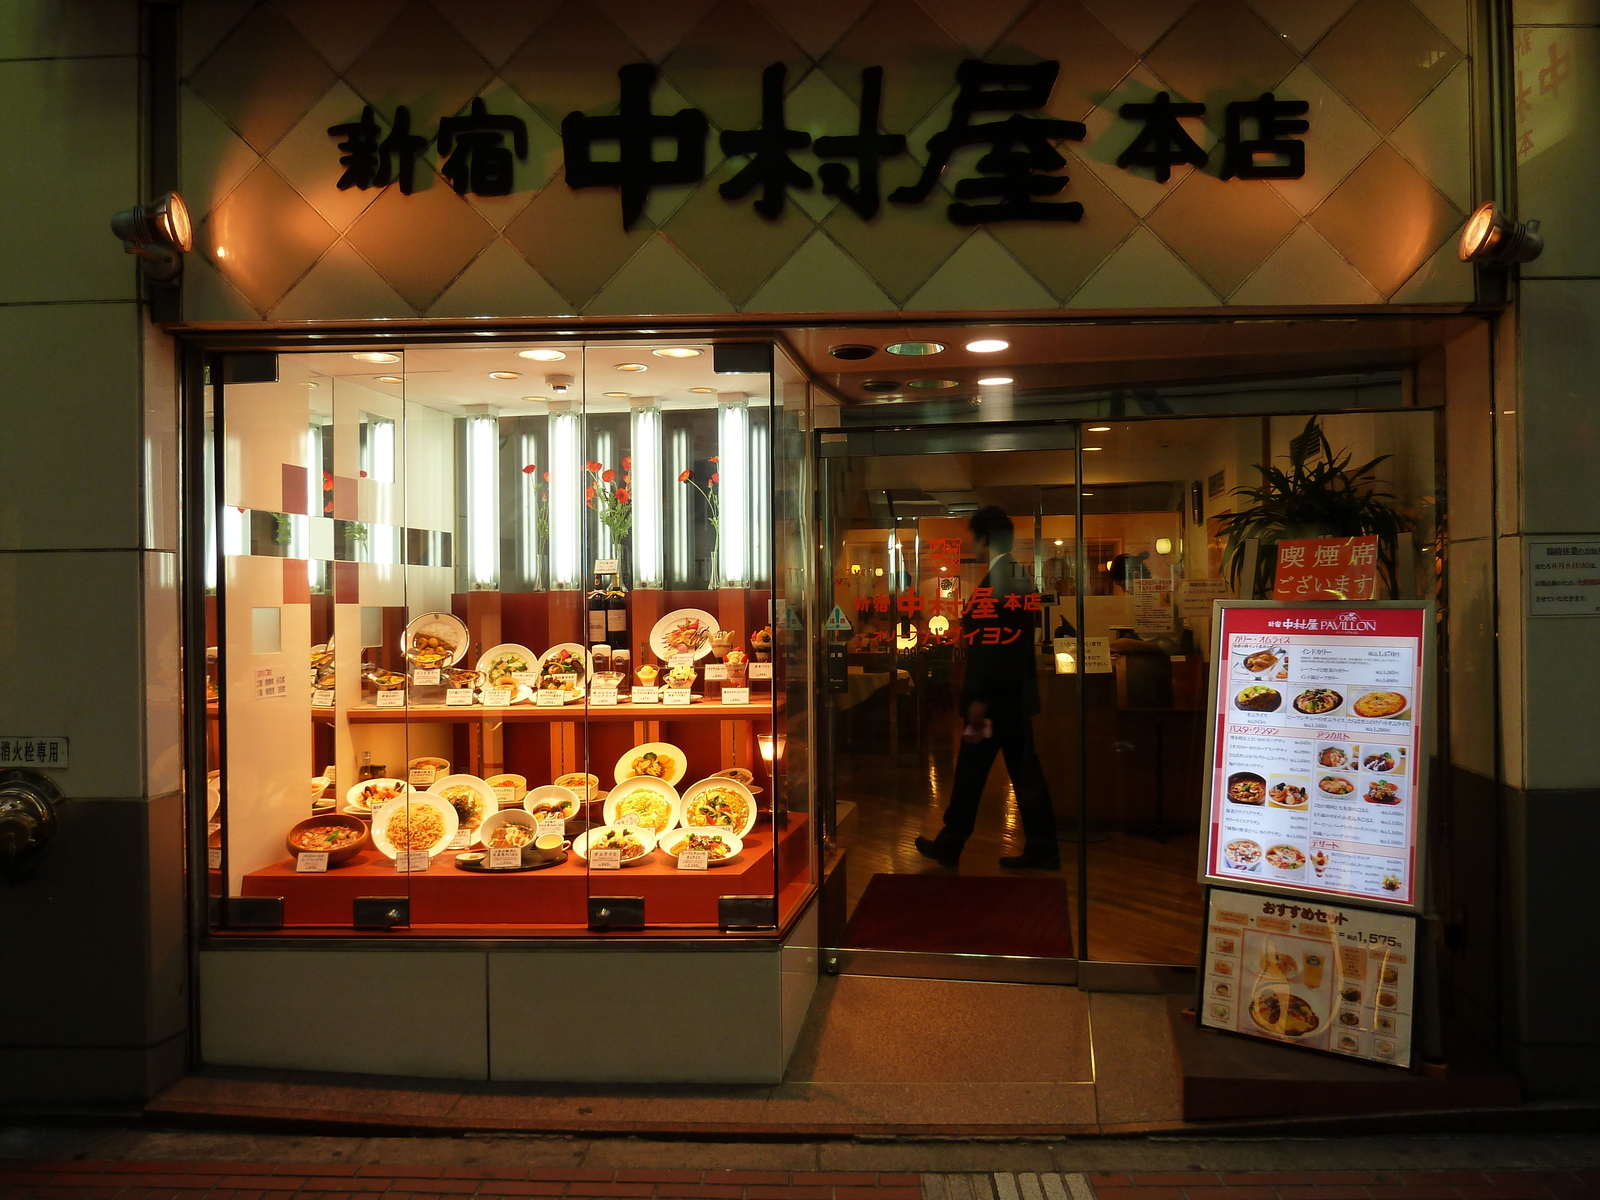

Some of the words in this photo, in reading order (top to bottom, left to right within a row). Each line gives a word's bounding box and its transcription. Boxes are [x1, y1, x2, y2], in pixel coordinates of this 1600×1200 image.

[1280, 543, 1375, 569] 喫煙席
[1277, 574, 1373, 594] ございます
[1320, 621, 1377, 631] PAVILLON
[1316, 731, 1351, 740] アラカルト
[1, 740, 58, 763] 消火栓専用
[1312, 840, 1339, 850] デザート
[1262, 901, 1348, 926] おすすめセット
